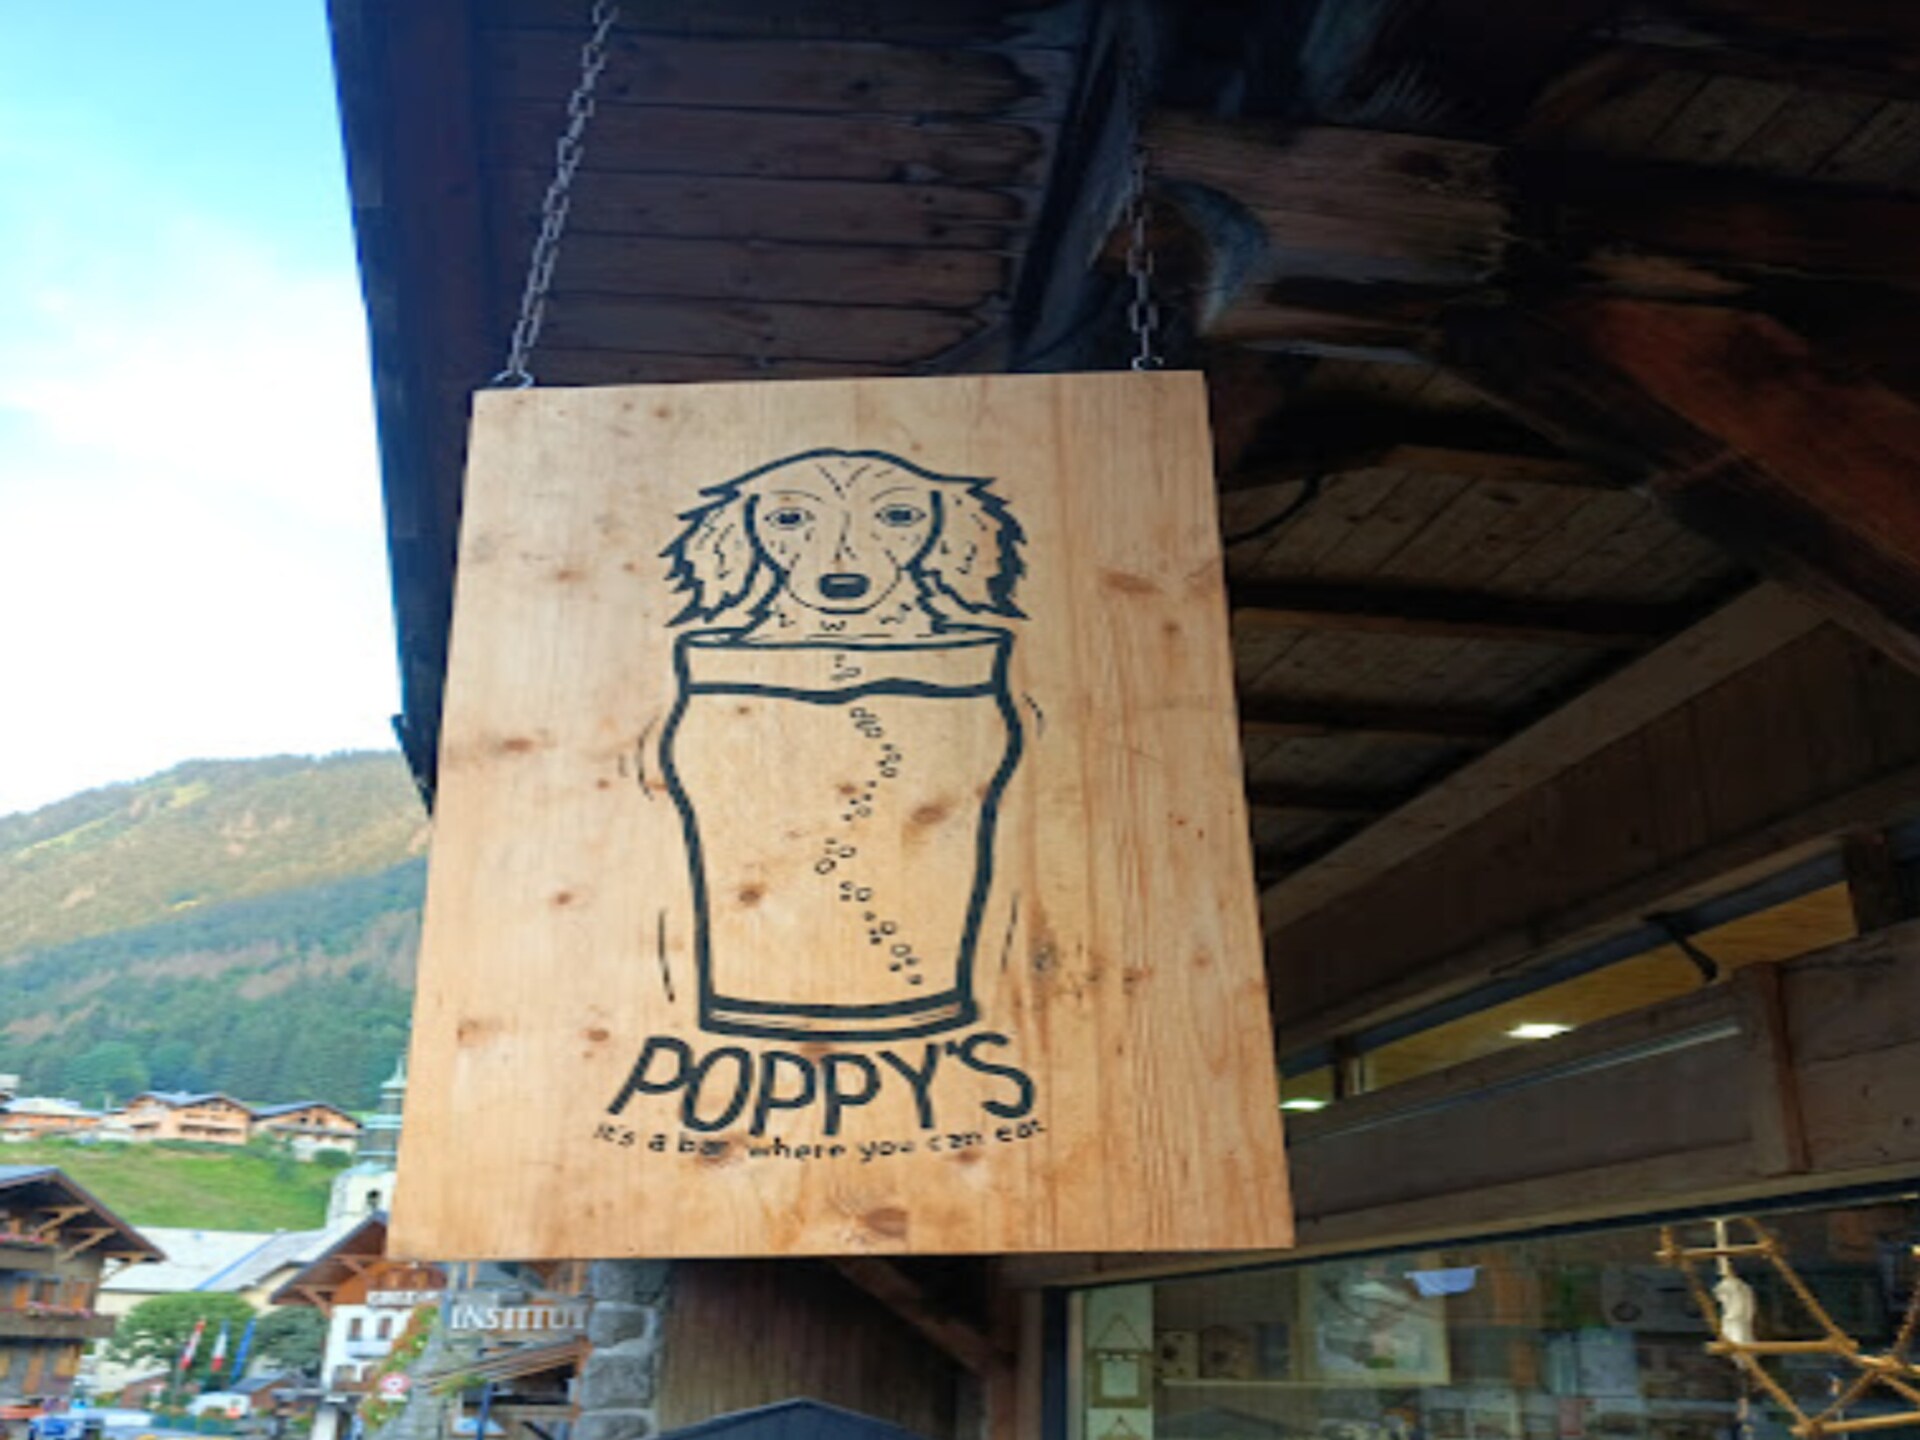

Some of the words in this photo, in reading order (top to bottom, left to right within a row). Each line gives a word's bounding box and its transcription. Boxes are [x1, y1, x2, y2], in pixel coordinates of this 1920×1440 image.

[607, 1032, 1035, 1136] POPPY'S
[648, 1133, 666, 1152] a
[749, 1136, 846, 1161] where
[927, 1131, 985, 1152] can
[995, 1117, 1048, 1143] eat
